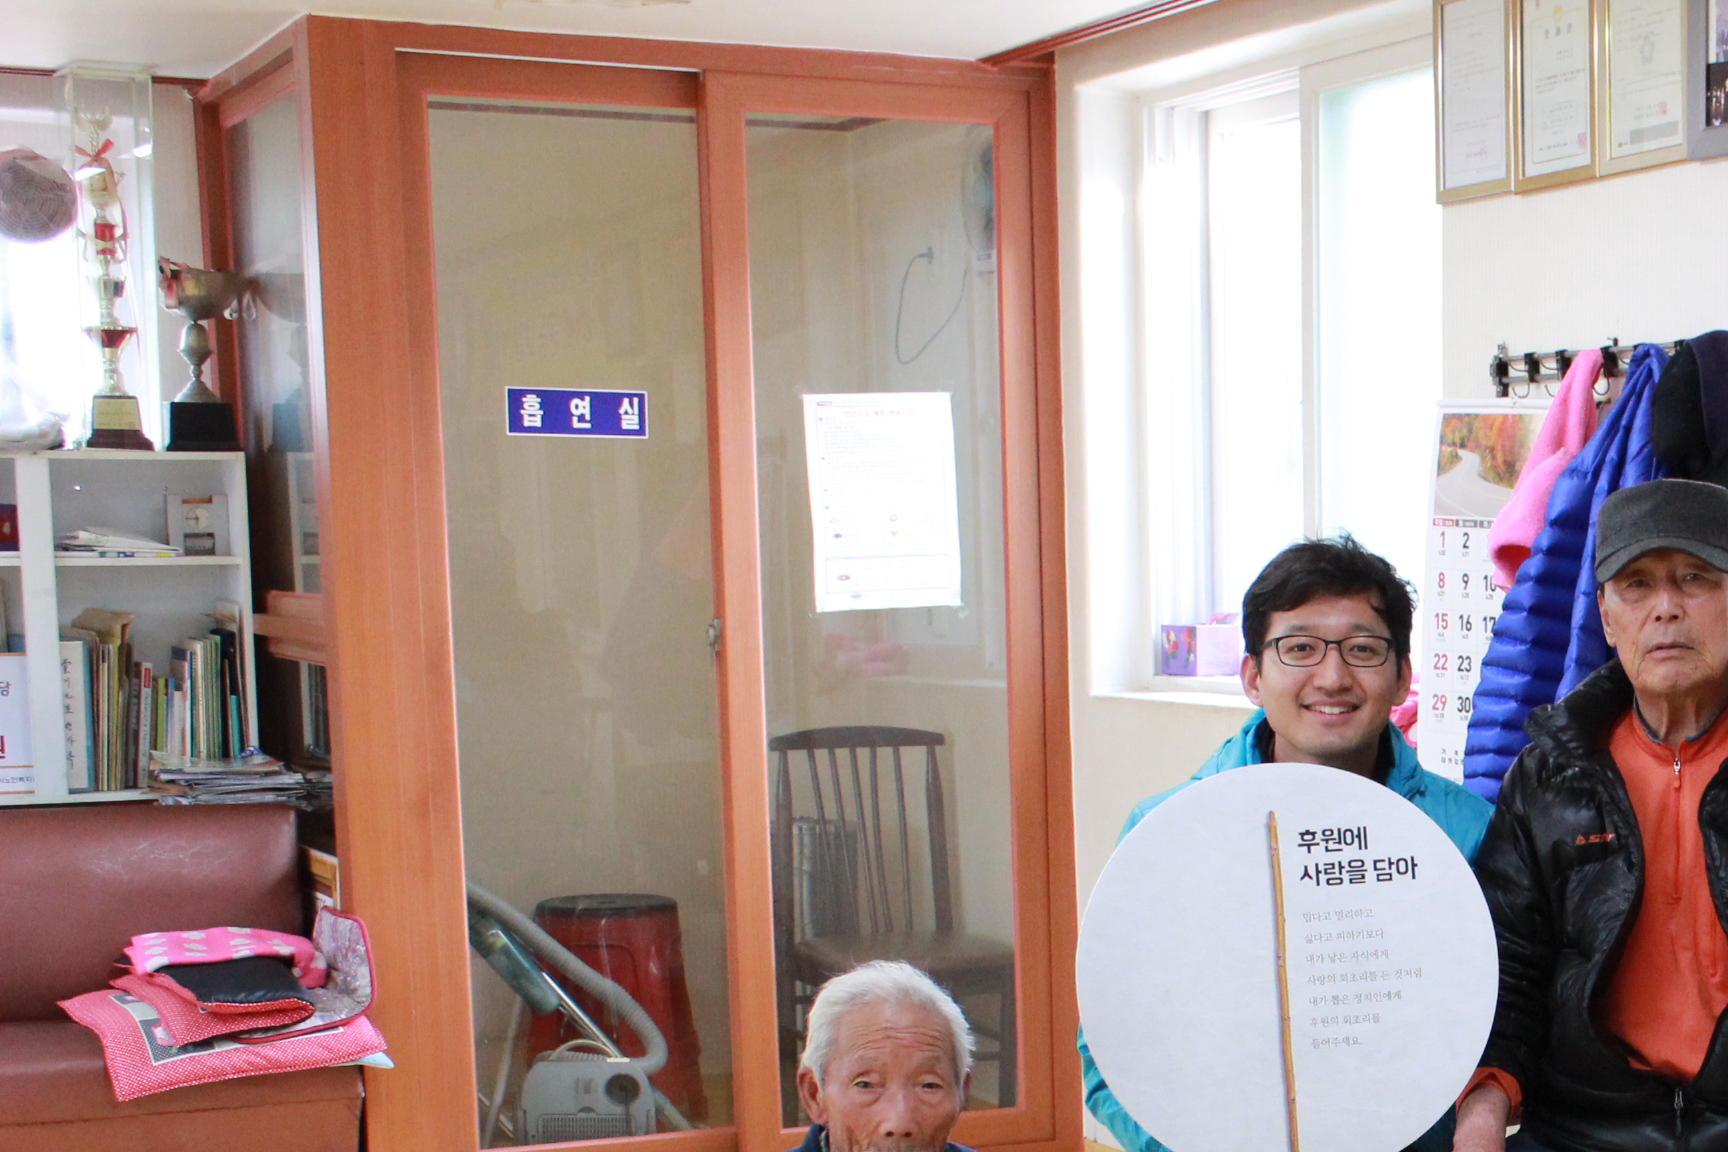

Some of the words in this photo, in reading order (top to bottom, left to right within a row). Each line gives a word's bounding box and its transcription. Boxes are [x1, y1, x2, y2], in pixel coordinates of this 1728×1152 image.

[1440, 530, 1446, 549] 1
[1462, 531, 1470, 550] 2
[1437, 571, 1446, 590] 8
[1461, 572, 1470, 591] 9
[1482, 574, 1497, 592] 10
[1434, 612, 1449, 630] 15
[1458, 613, 1473, 632] 16
[1482, 615, 1497, 634] 17
[1433, 653, 1448, 671] 22
[1457, 654, 1472, 673] 23
[1432, 693, 1448, 712] 29
[1457, 695, 1472, 714] 30
[1297, 826, 1368, 854] 후원에
[1300, 859, 1368, 887] 사랑을
[1372, 855, 1418, 882] 담아
[1336, 928, 1386, 942] 피하기보다
[1305, 953, 1325, 965] 내가
[1350, 948, 1390, 962] 자식에게
[1307, 973, 1336, 986] 사랑의
[1339, 970, 1378, 984] 회초리를
[1394, 967, 1423, 981] 것처럼
[1308, 995, 1328, 1007] 내가
[1354, 990, 1402, 1004] 정치인에게
[1310, 1015, 1339, 1028] 후원의
[1342, 1012, 1381, 1026] 회초리를
